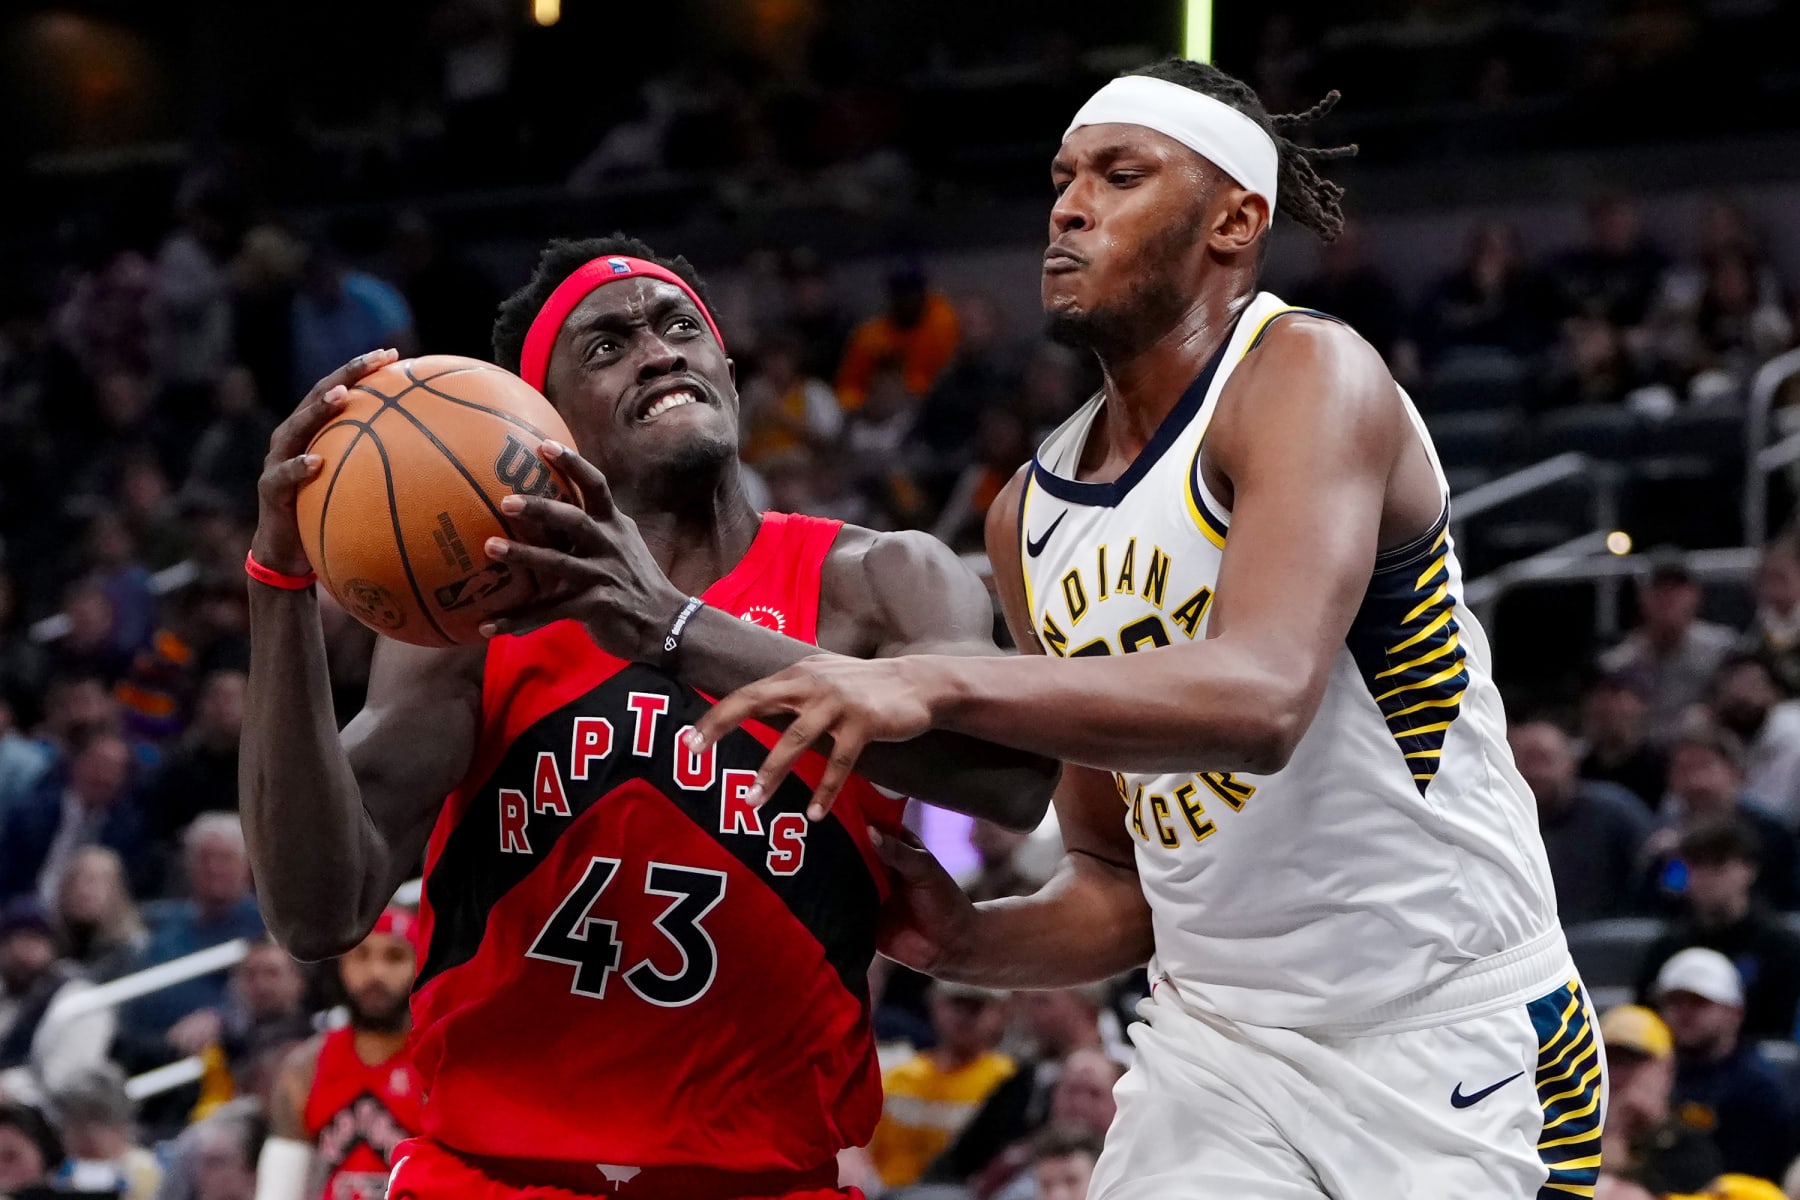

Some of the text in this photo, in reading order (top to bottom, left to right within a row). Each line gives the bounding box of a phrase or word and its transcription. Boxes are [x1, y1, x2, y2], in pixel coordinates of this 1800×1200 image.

[1042, 536, 1215, 658] NDIANA
[499, 691, 808, 876] RAPTORS
[1115, 771, 1257, 849] PACER
[524, 856, 728, 1008] 43
